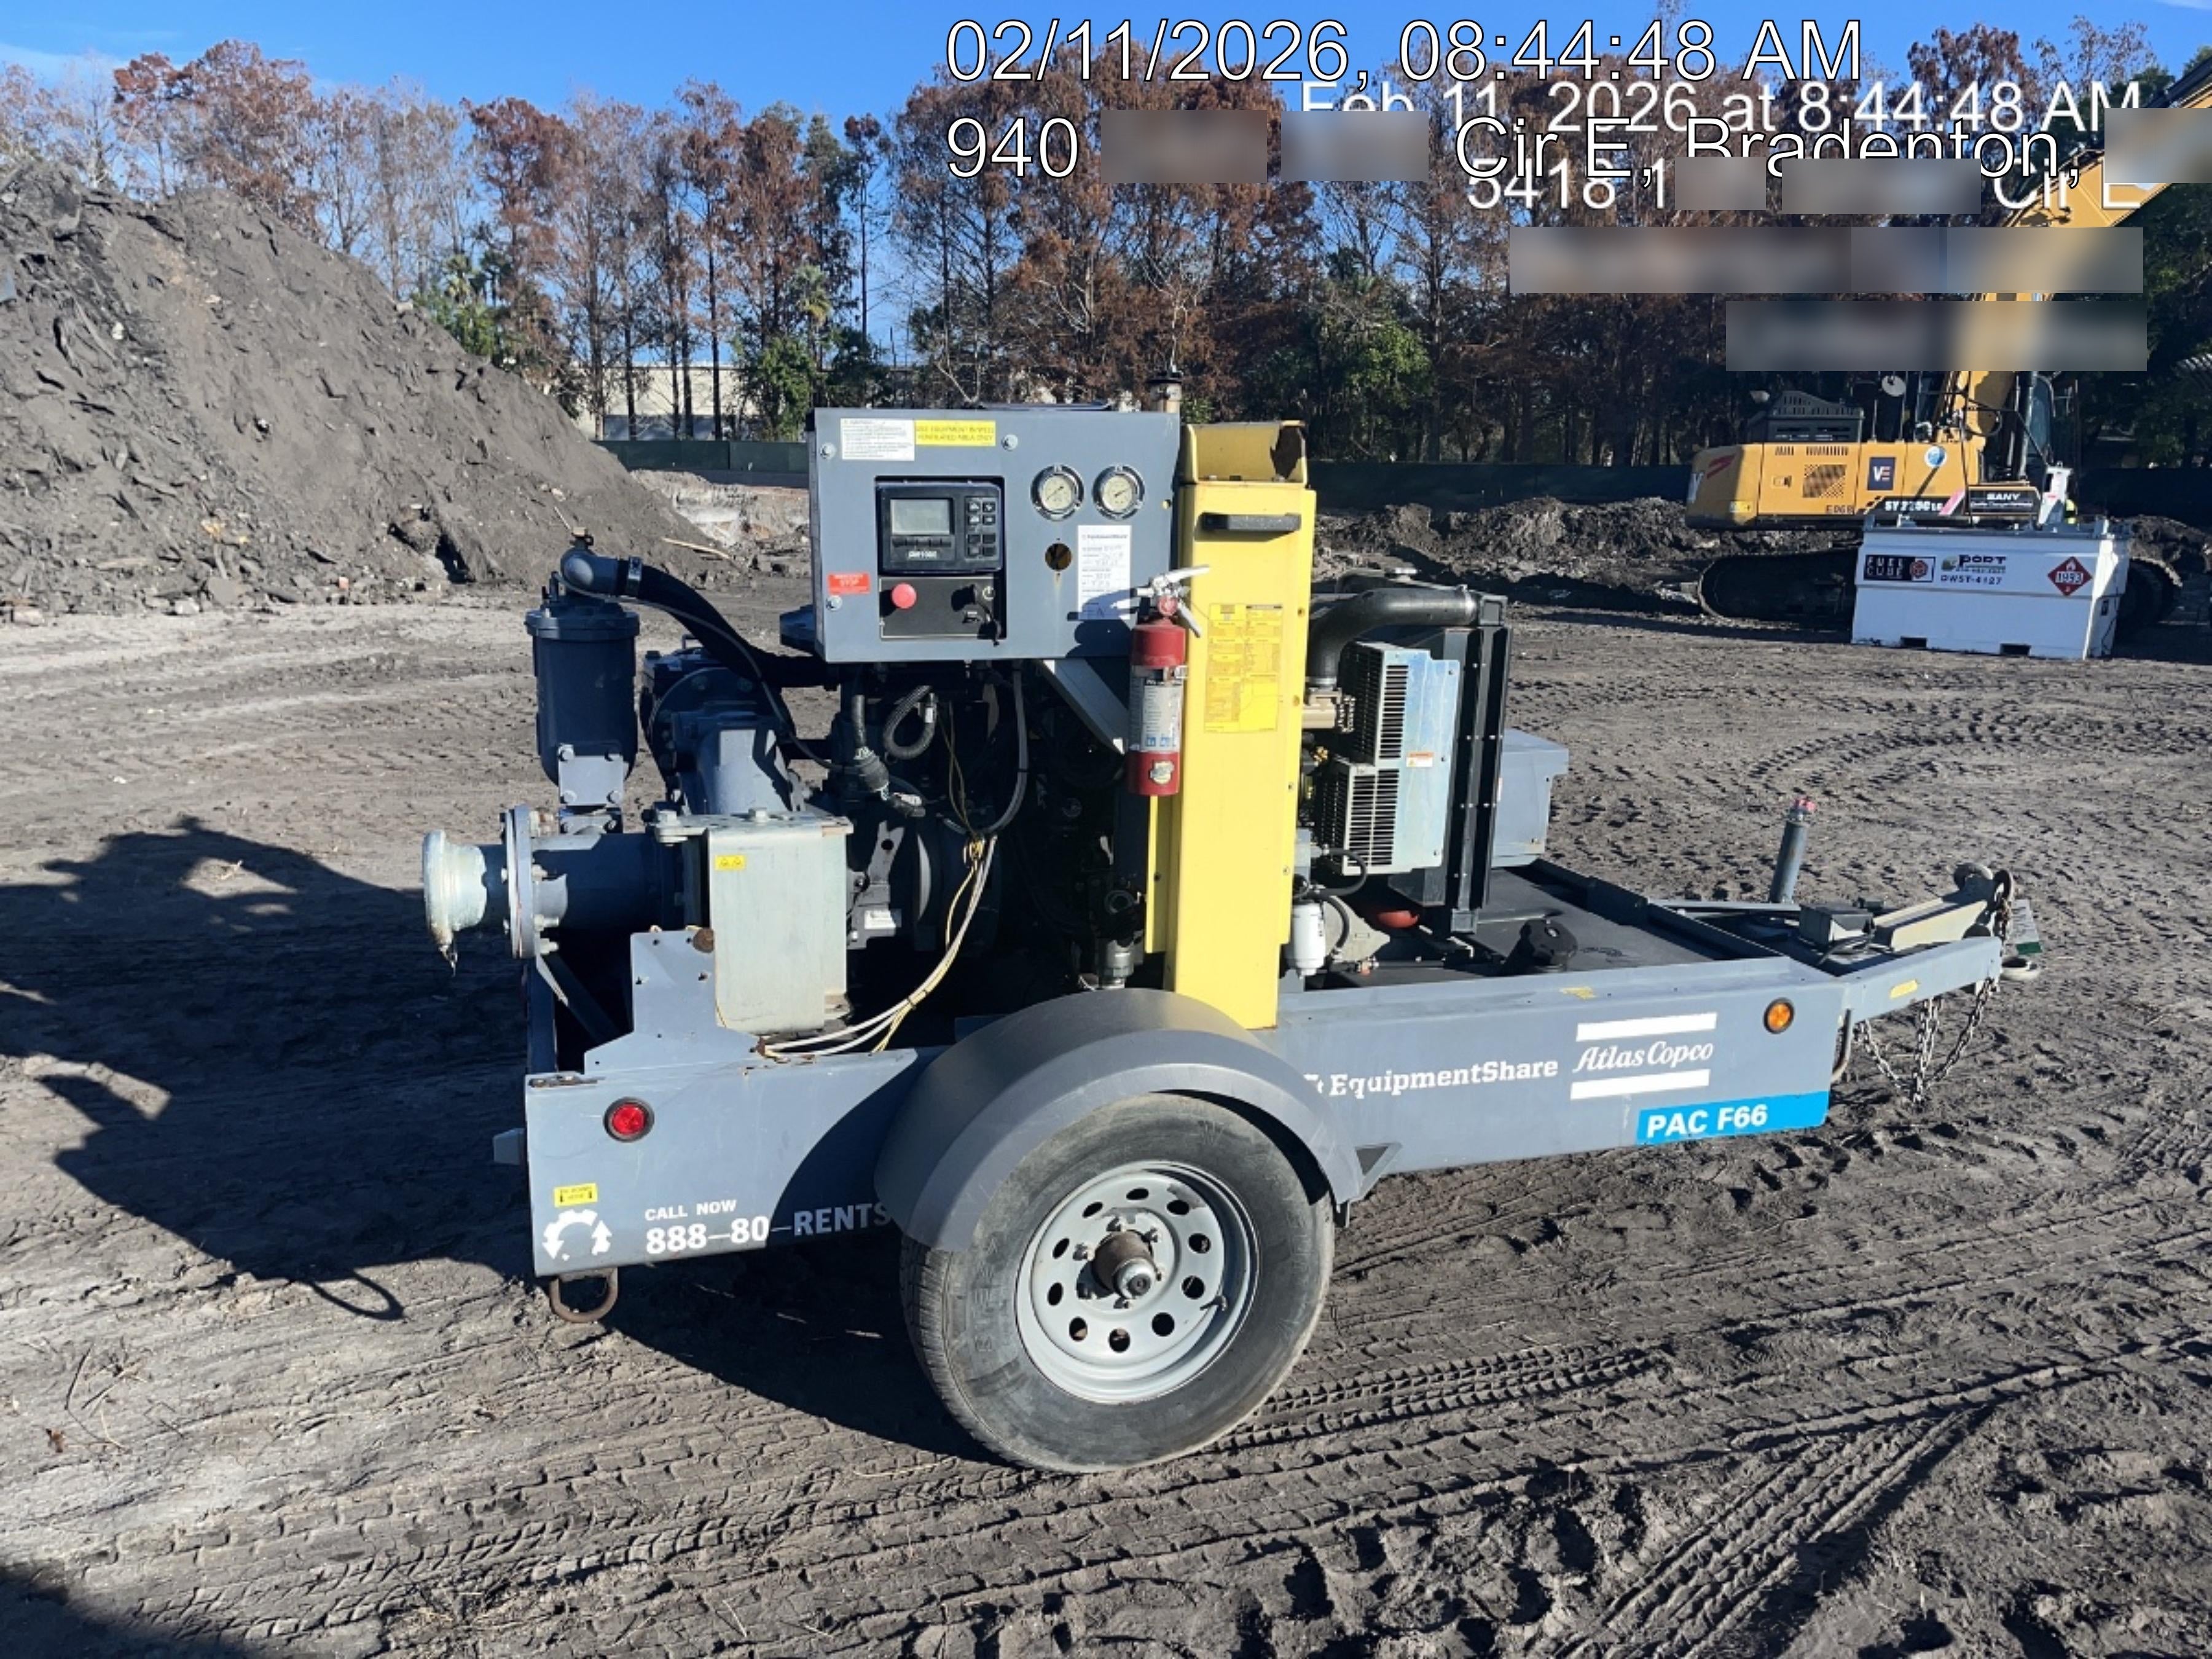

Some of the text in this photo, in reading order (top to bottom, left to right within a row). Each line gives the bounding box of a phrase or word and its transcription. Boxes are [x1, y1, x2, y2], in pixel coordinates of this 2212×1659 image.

[1571, 1041, 1714, 1074] Atlas Copco
[1328, 1058, 1558, 1100] EquipmentShare
[1647, 1104, 1768, 1138] PAC F66
[645, 1199, 737, 1221] CALL NOW
